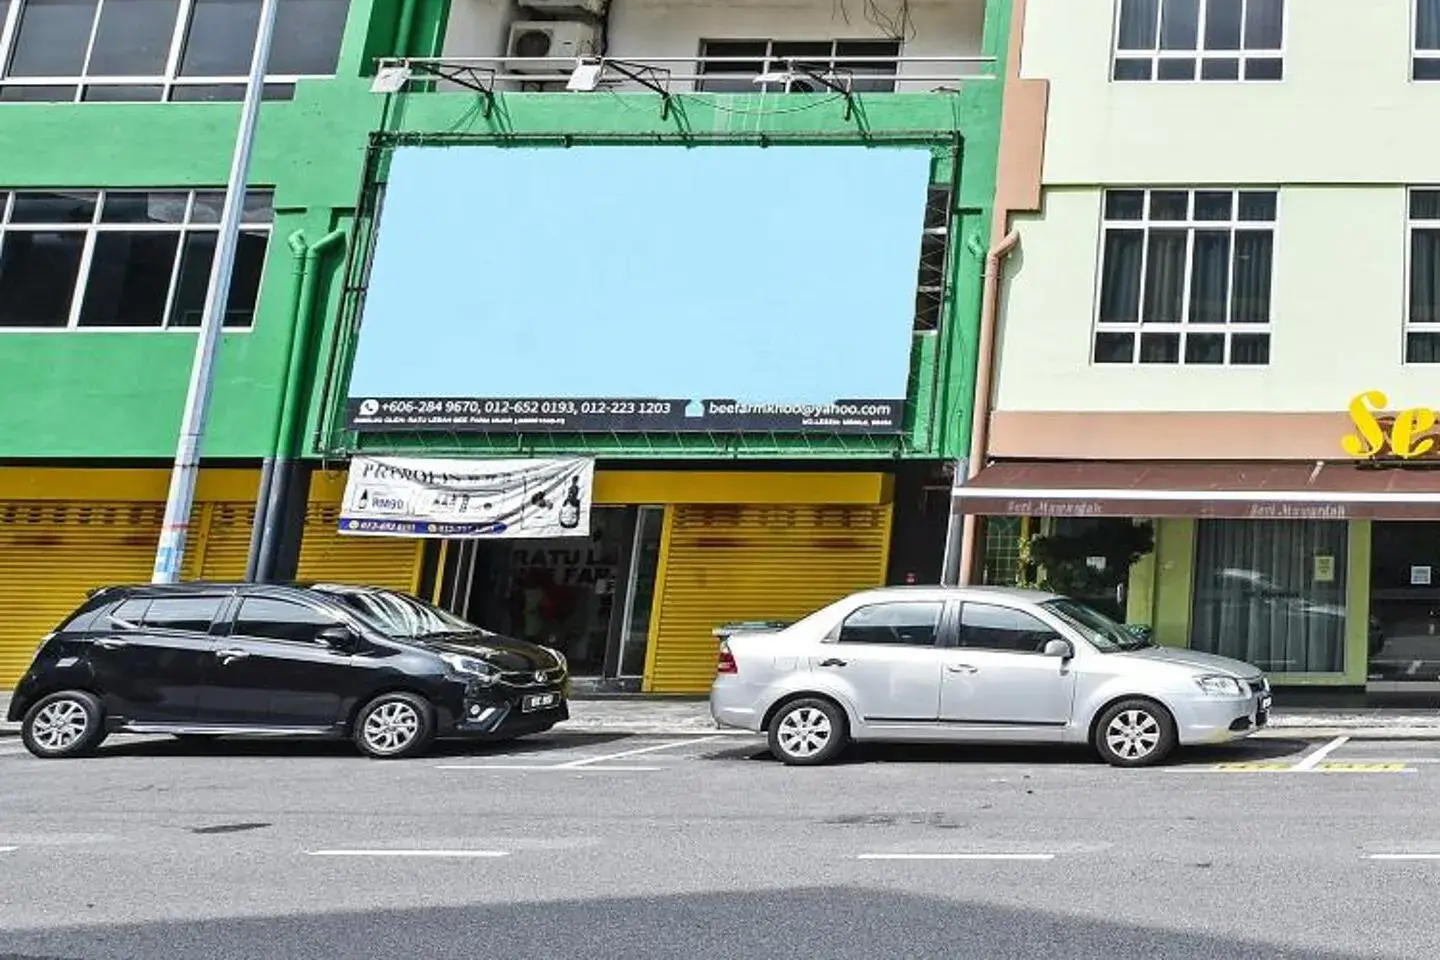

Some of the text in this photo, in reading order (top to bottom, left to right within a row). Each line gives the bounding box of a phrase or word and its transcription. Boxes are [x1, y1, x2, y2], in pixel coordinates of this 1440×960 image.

[382, 400, 442, 413] +606-284
[485, 400, 539, 414] 012-652
[581, 401, 635, 414] 012-223
[638, 402, 671, 414] 1203
